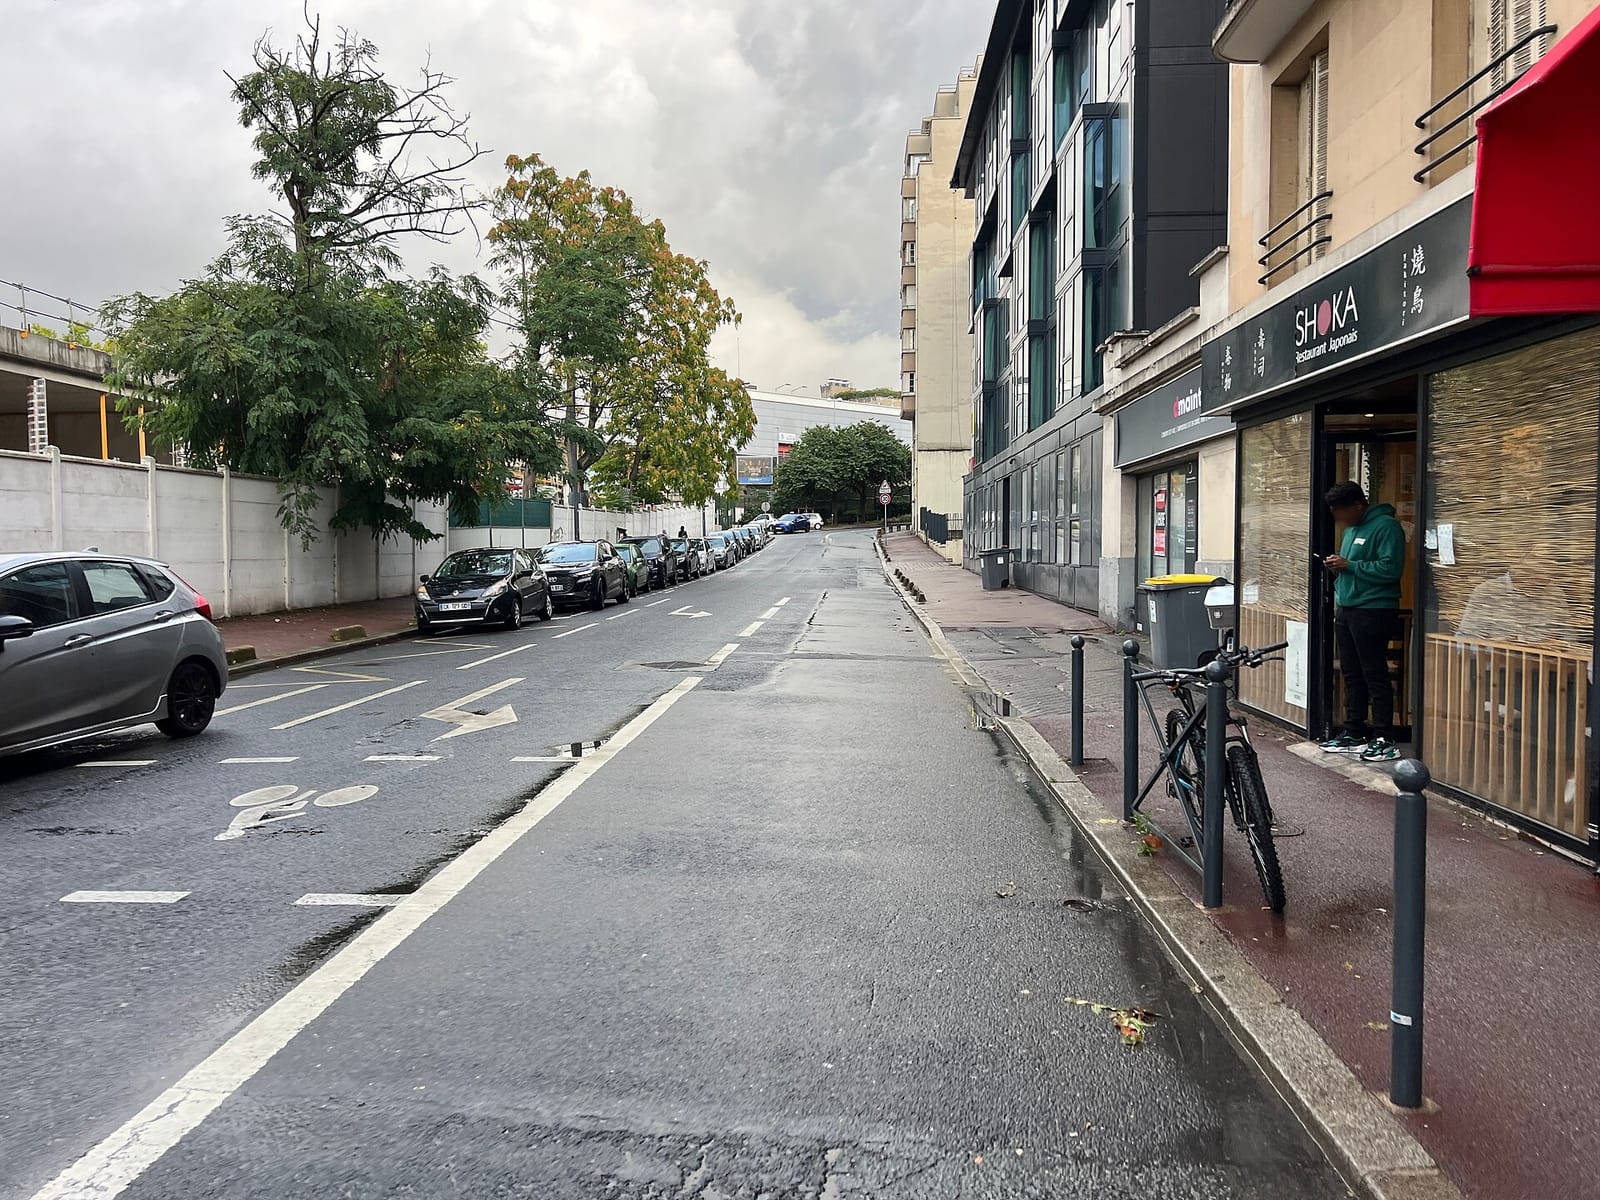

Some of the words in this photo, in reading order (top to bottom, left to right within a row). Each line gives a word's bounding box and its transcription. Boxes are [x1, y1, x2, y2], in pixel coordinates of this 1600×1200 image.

[1295, 285, 1359, 347] SHOKA
[1295, 341, 1327, 364] Restaurant
[1328, 328, 1358, 353] Japonais
